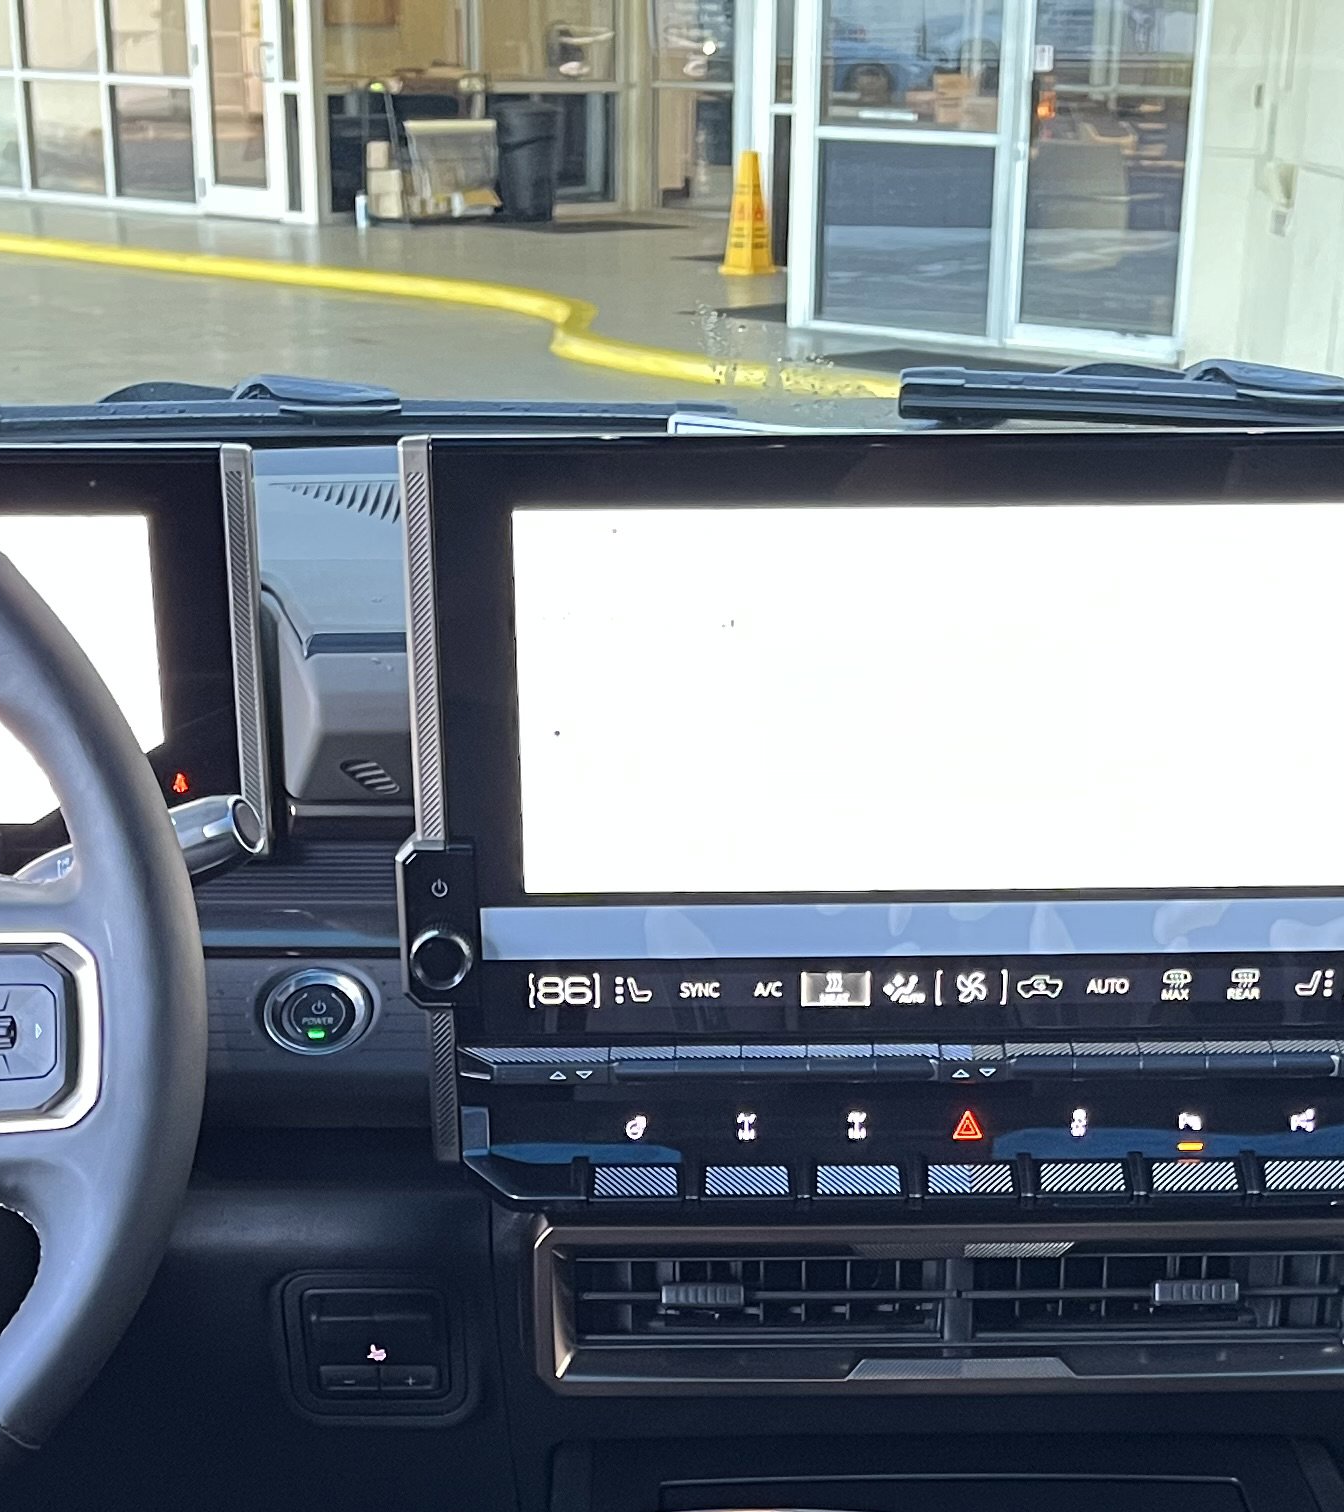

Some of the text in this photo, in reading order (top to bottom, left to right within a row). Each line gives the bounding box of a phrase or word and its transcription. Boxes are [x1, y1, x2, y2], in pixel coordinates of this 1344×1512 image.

[536, 976, 594, 1005] 86
[679, 981, 721, 999] SYNC
[754, 981, 784, 998] A/C
[1086, 978, 1130, 995] AUTO
[1160, 988, 1191, 1001] MAX
[1226, 987, 1261, 1000] REAR
[301, 1016, 334, 1026] POWER
